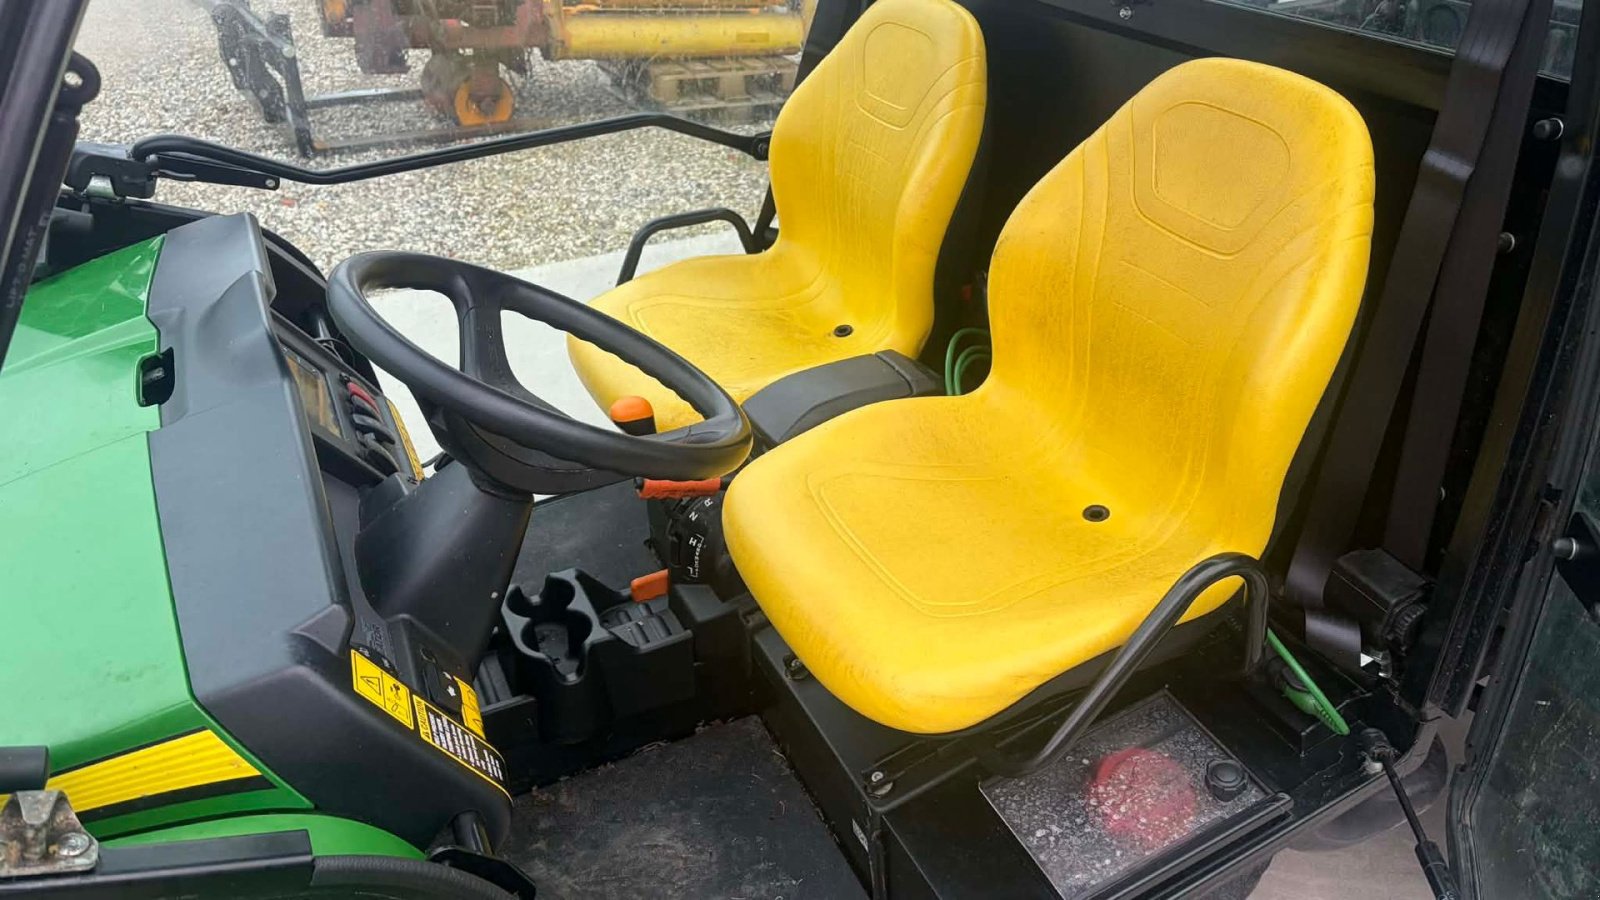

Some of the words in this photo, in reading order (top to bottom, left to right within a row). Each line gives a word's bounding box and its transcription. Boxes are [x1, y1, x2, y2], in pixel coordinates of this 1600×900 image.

[704, 498, 714, 507] R
[689, 511, 699, 521] N
[688, 537, 698, 547] H
[416, 700, 429, 731] CAUTION
